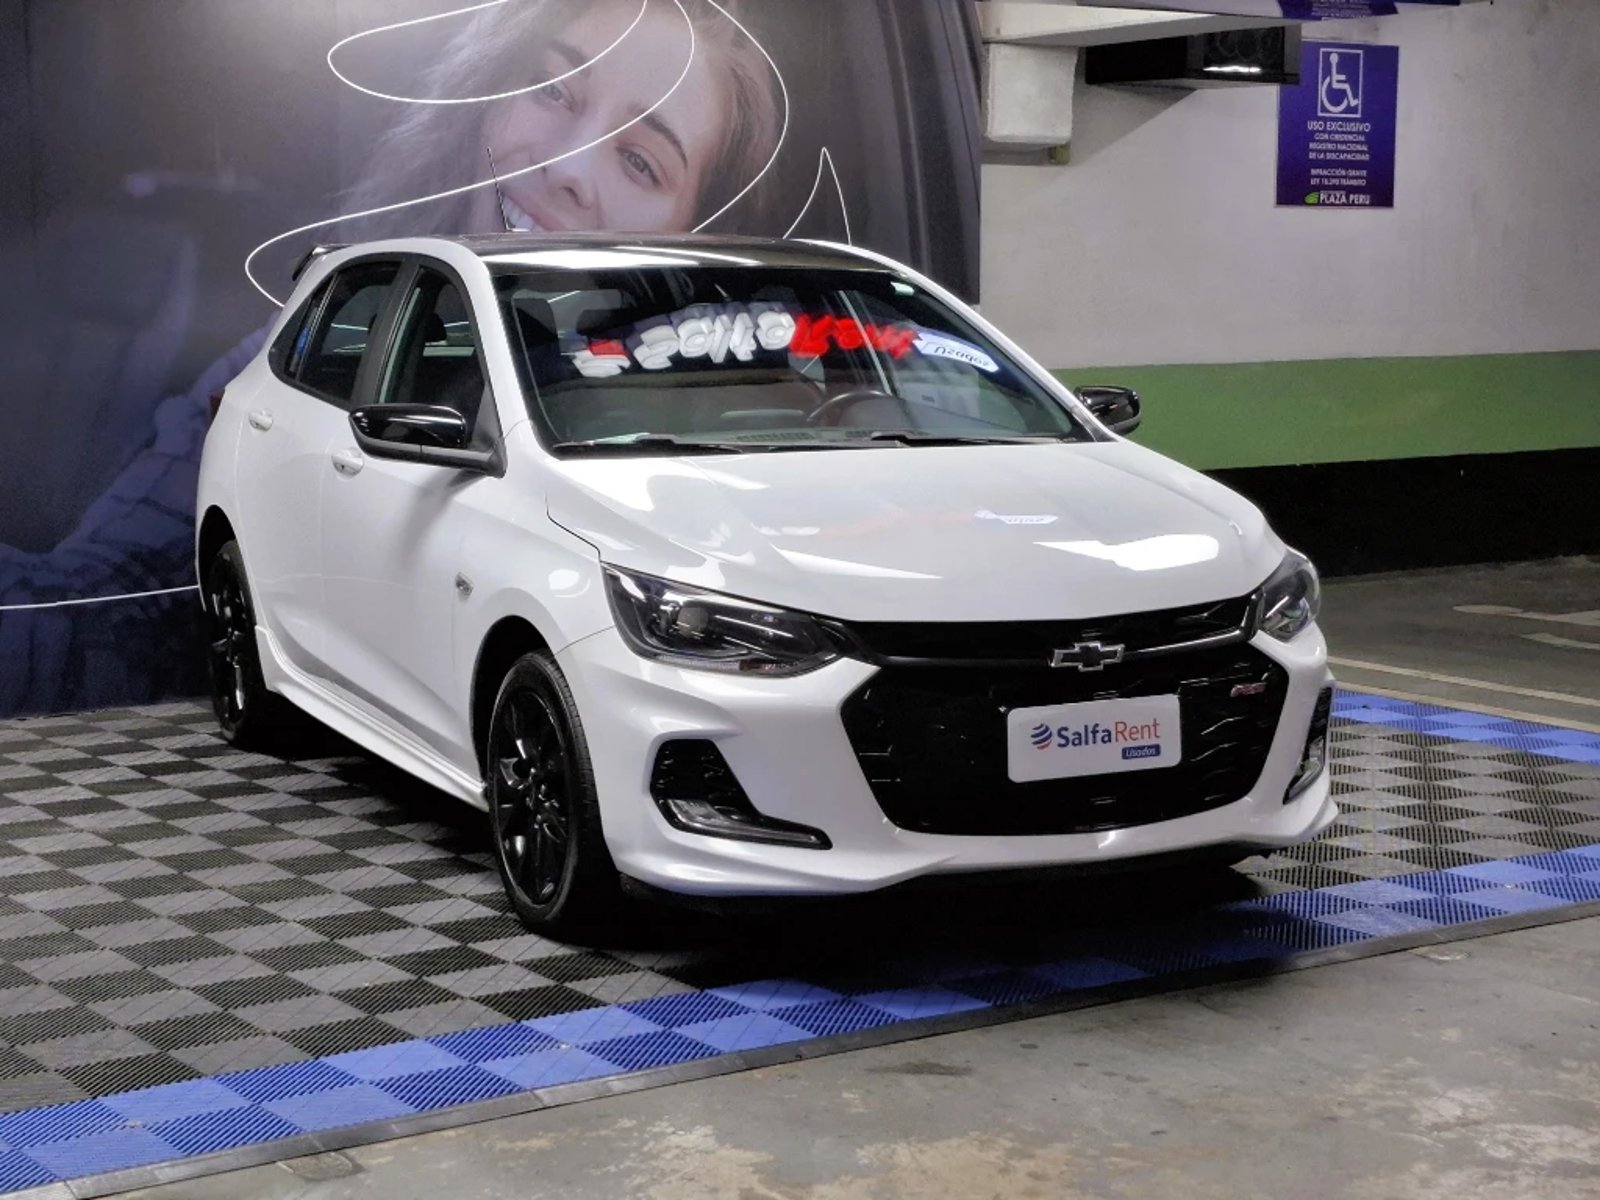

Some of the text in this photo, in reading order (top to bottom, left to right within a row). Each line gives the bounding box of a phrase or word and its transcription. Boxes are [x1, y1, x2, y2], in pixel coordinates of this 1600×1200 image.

[1307, 120, 1371, 132] USO EXCLUSIVO
[1314, 132, 1365, 141] CON CREDENCIAL
[1309, 142, 1368, 151] REGISTRO NACIONAL
[1326, 152, 1370, 161] DISCAPACIDAD
[1310, 177, 1320, 185] LEY
[1320, 192, 1347, 204] PLAZA
[1125, 746, 1156, 757] Usados
